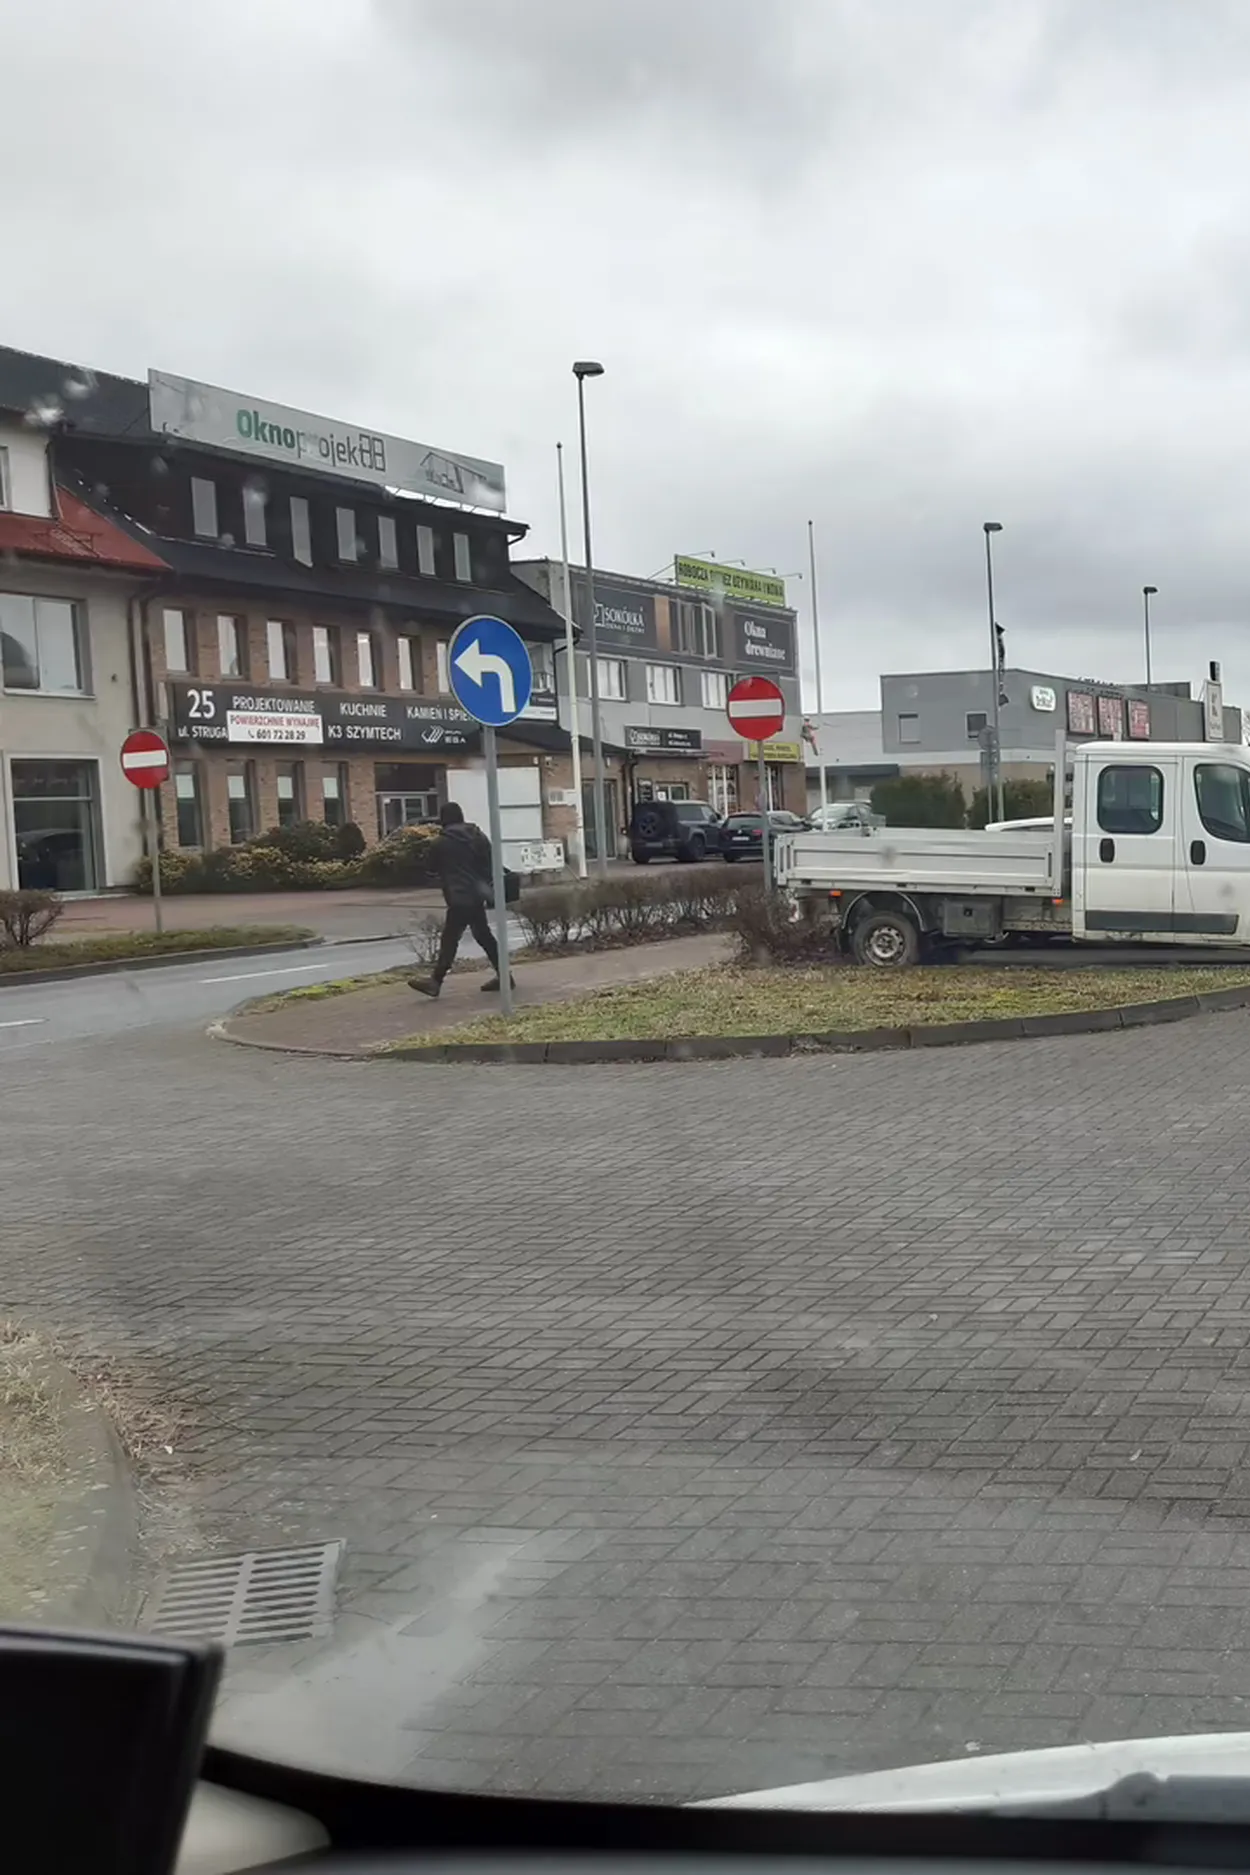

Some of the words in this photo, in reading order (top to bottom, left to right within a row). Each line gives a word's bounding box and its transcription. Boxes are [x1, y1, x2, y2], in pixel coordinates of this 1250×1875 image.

[236, 409, 374, 470] Oknopojekt
[187, 689, 215, 719] 25
[232, 696, 316, 712] PROJEKTOWANIE
[340, 702, 387, 718] KUCHNIE
[230, 715, 285, 727] POWIERZCHNIE
[178, 725, 189, 738] ul.
[192, 726, 229, 739] STRUGA
[257, 729, 271, 739] 601
[273, 730, 283, 739] 72
[284, 730, 294, 740] 28
[296, 730, 306, 740] 29
[328, 725, 342, 739] K3
[346, 725, 402, 741] SZYMTECH
